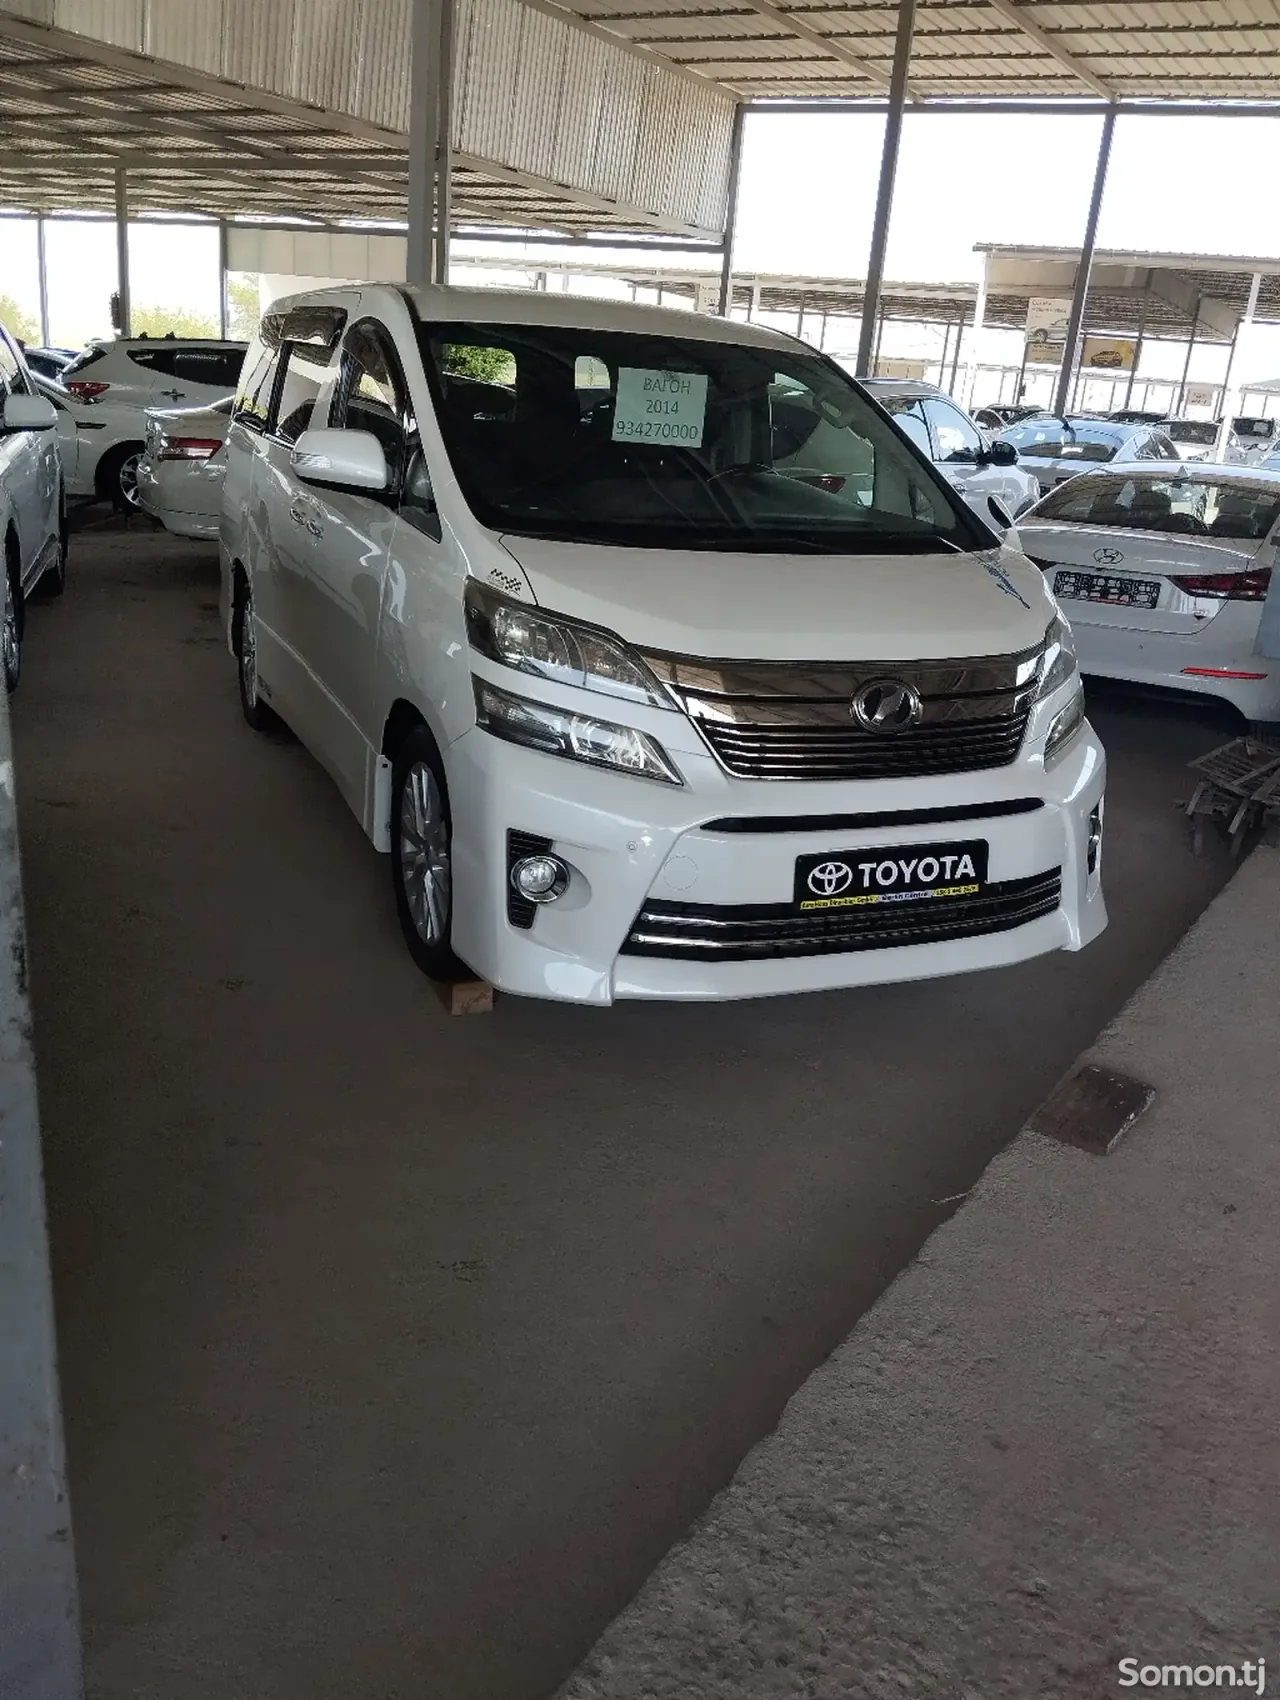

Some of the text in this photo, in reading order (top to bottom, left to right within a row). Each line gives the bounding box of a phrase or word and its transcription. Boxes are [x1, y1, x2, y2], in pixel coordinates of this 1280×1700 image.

[643, 377, 691, 394] ВАГОН
[645, 399, 679, 415] 2014
[615, 420, 699, 440] 934270000
[858, 854, 976, 888] TOYOTA
